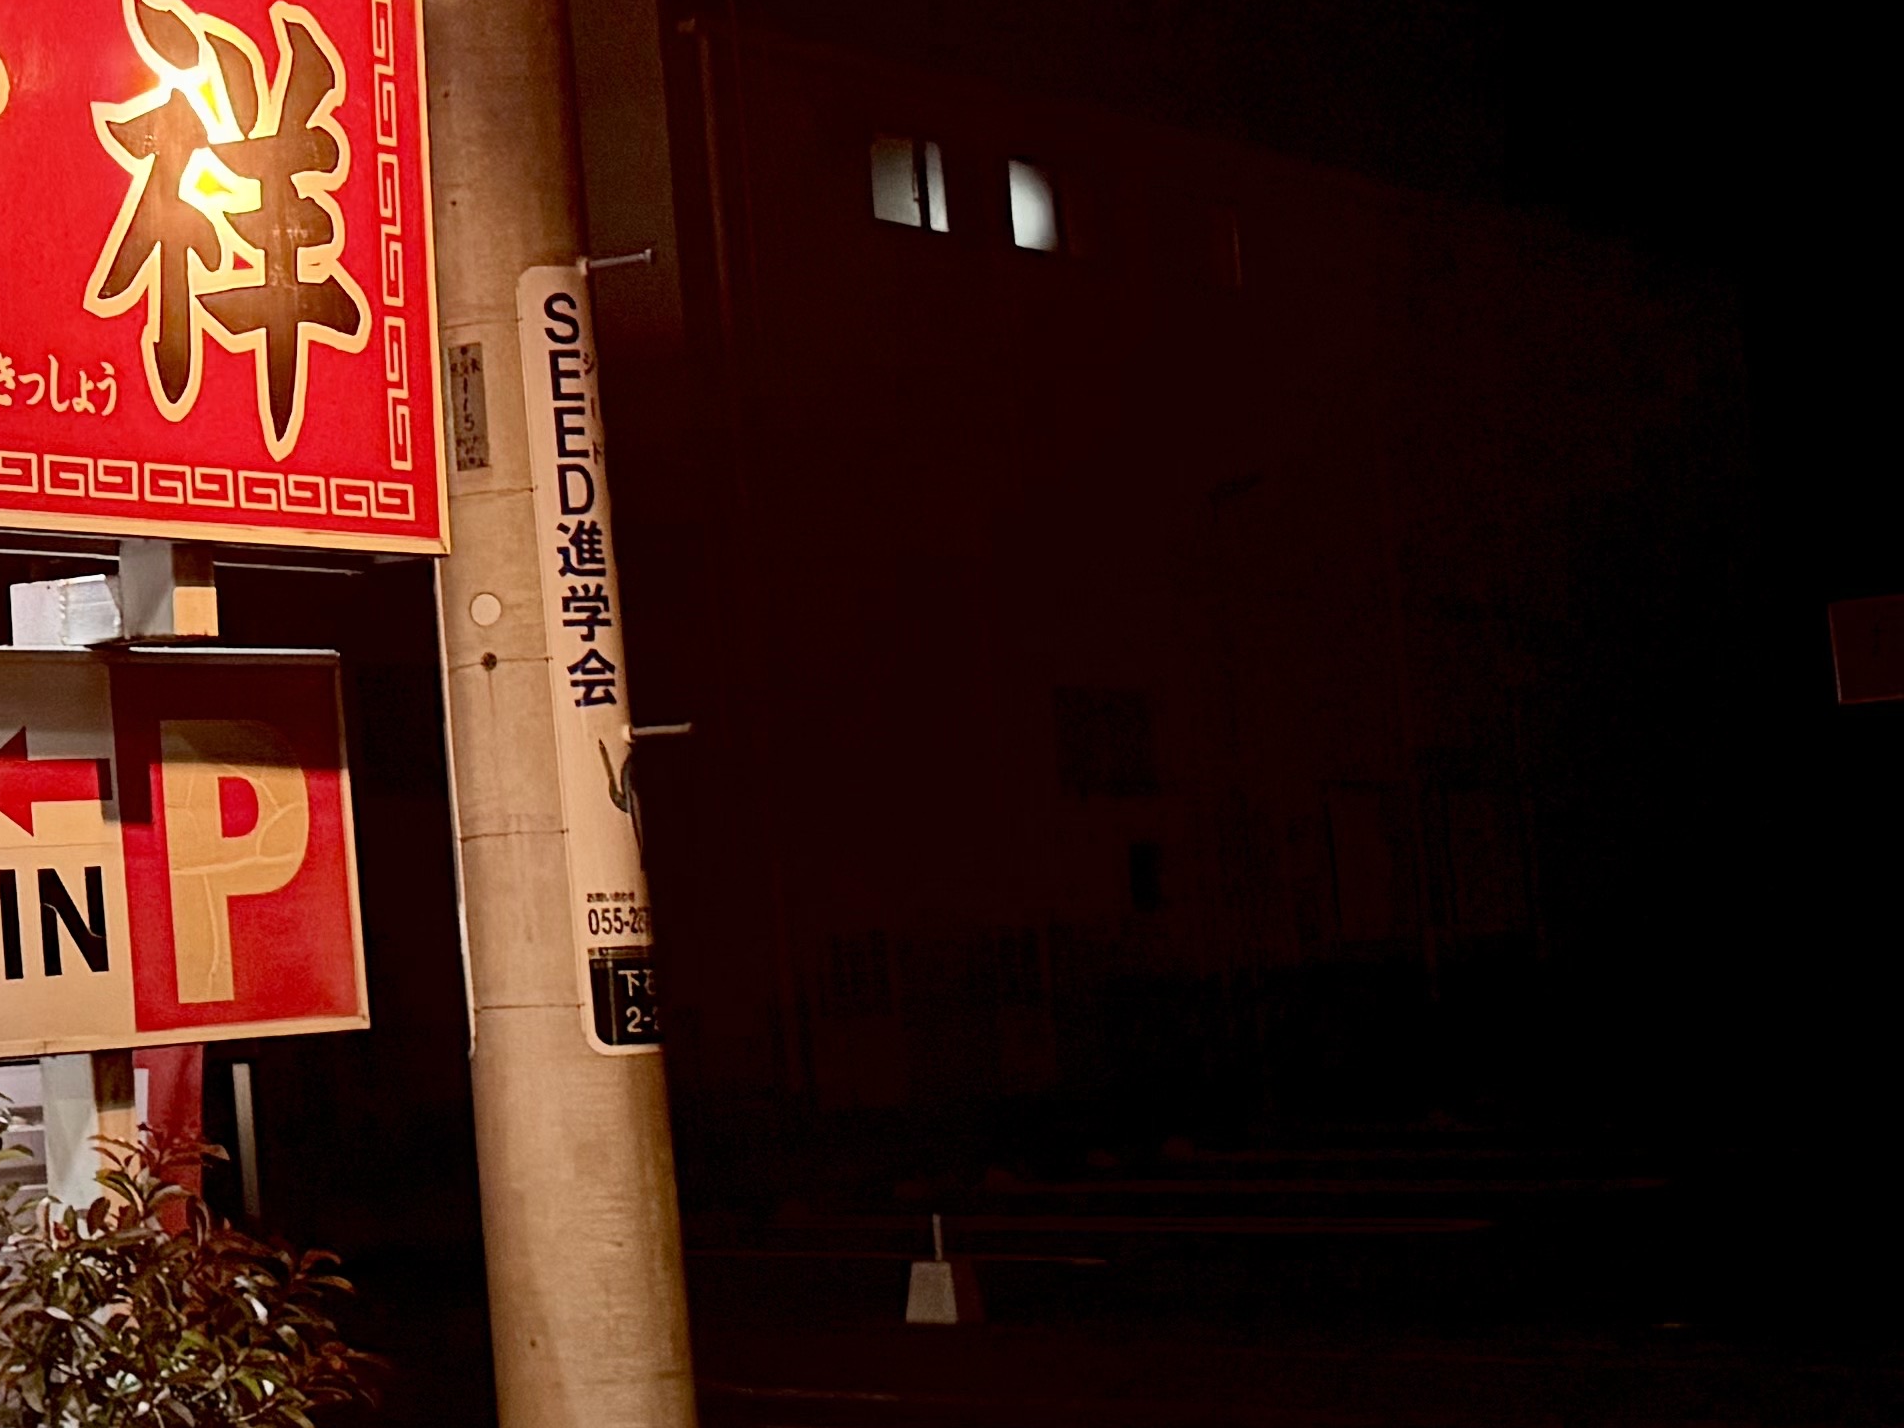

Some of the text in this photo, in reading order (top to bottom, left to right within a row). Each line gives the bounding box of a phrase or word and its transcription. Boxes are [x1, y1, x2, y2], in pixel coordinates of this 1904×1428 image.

[543, 291, 618, 709] SEED進学会
[160, 719, 310, 1004] P
